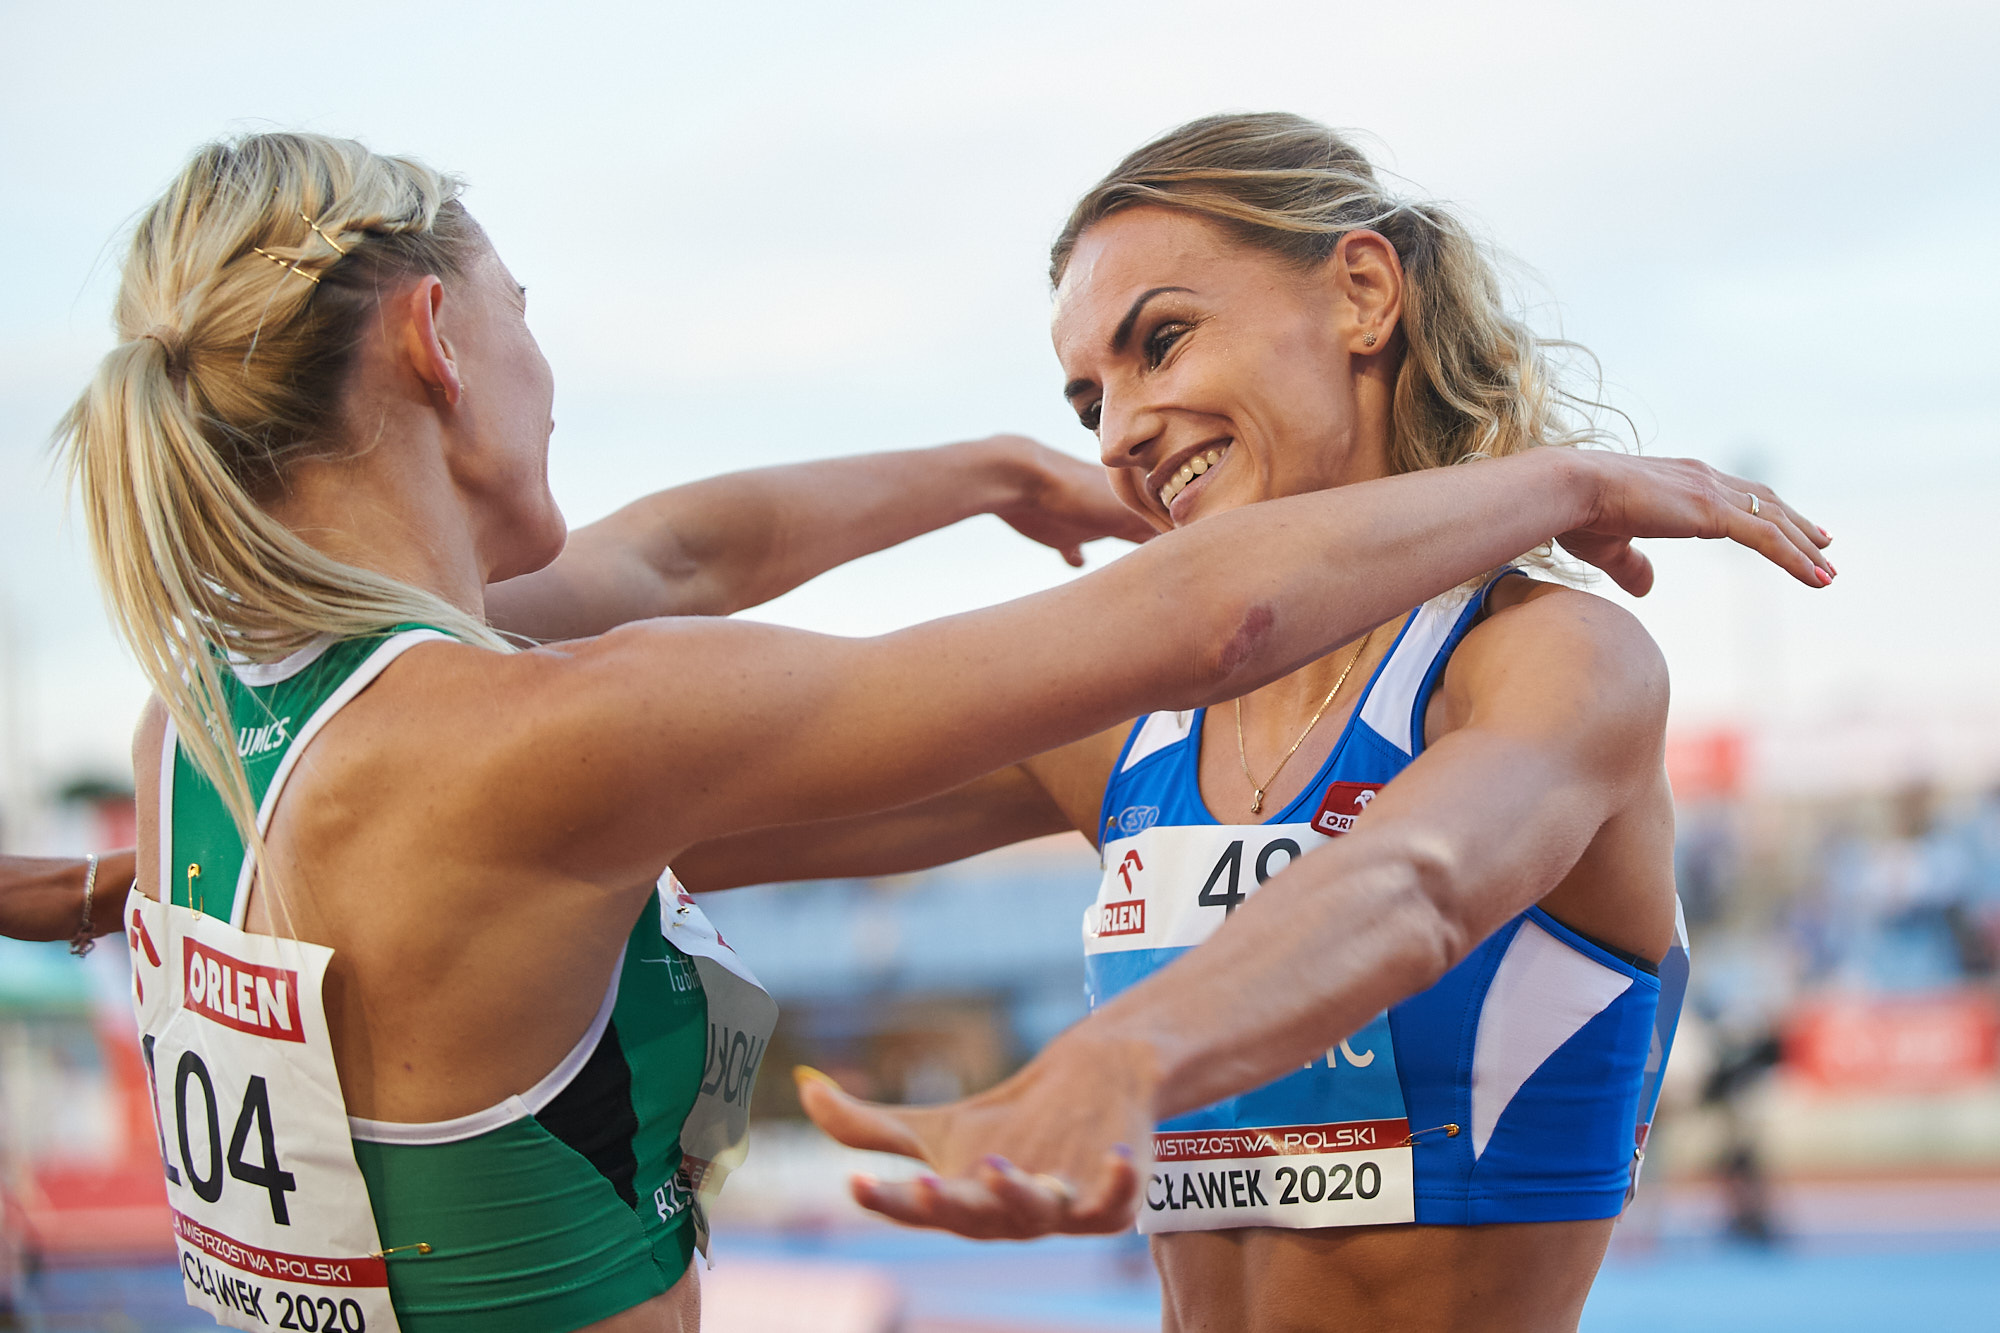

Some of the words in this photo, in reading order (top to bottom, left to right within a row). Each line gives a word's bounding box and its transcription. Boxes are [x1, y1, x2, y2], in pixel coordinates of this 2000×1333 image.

[238, 717, 291, 757] UMCS
[1096, 905, 1142, 933] RLEN
[190, 951, 292, 1031] ORLEN
[1151, 1135, 1277, 1157] MISTRZOSTWA
[1284, 1127, 1377, 1150] POLSKI
[1275, 1162, 1381, 1205] 2020
[275, 1258, 352, 1282] POLSKI
[180, 1251, 270, 1326] CŁAWEK
[276, 1291, 366, 1333] 2020
